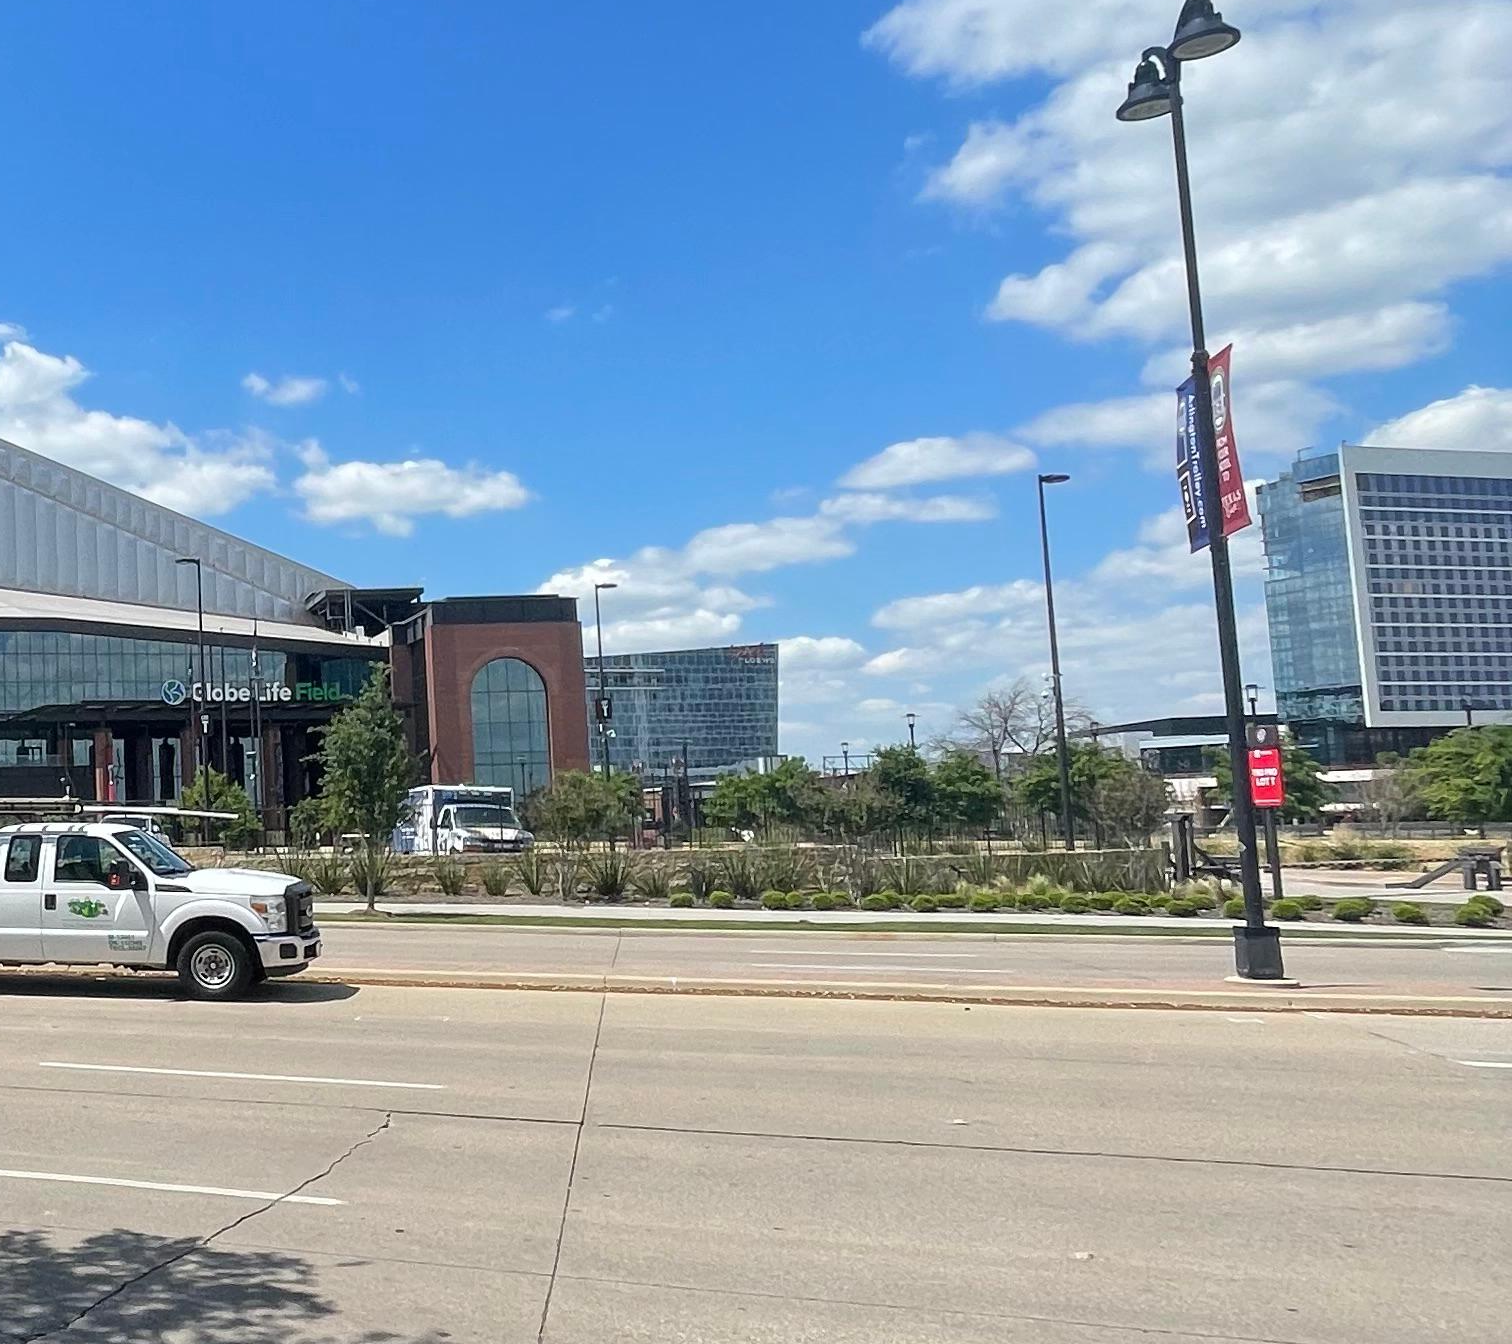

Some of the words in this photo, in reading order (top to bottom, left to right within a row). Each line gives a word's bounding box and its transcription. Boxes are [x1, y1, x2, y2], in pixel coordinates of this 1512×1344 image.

[1187, 393, 1208, 529] ArlingtonTrolley.com
[192, 681, 250, 702] Globe
[254, 681, 293, 702] Life
[295, 681, 341, 702] Field
